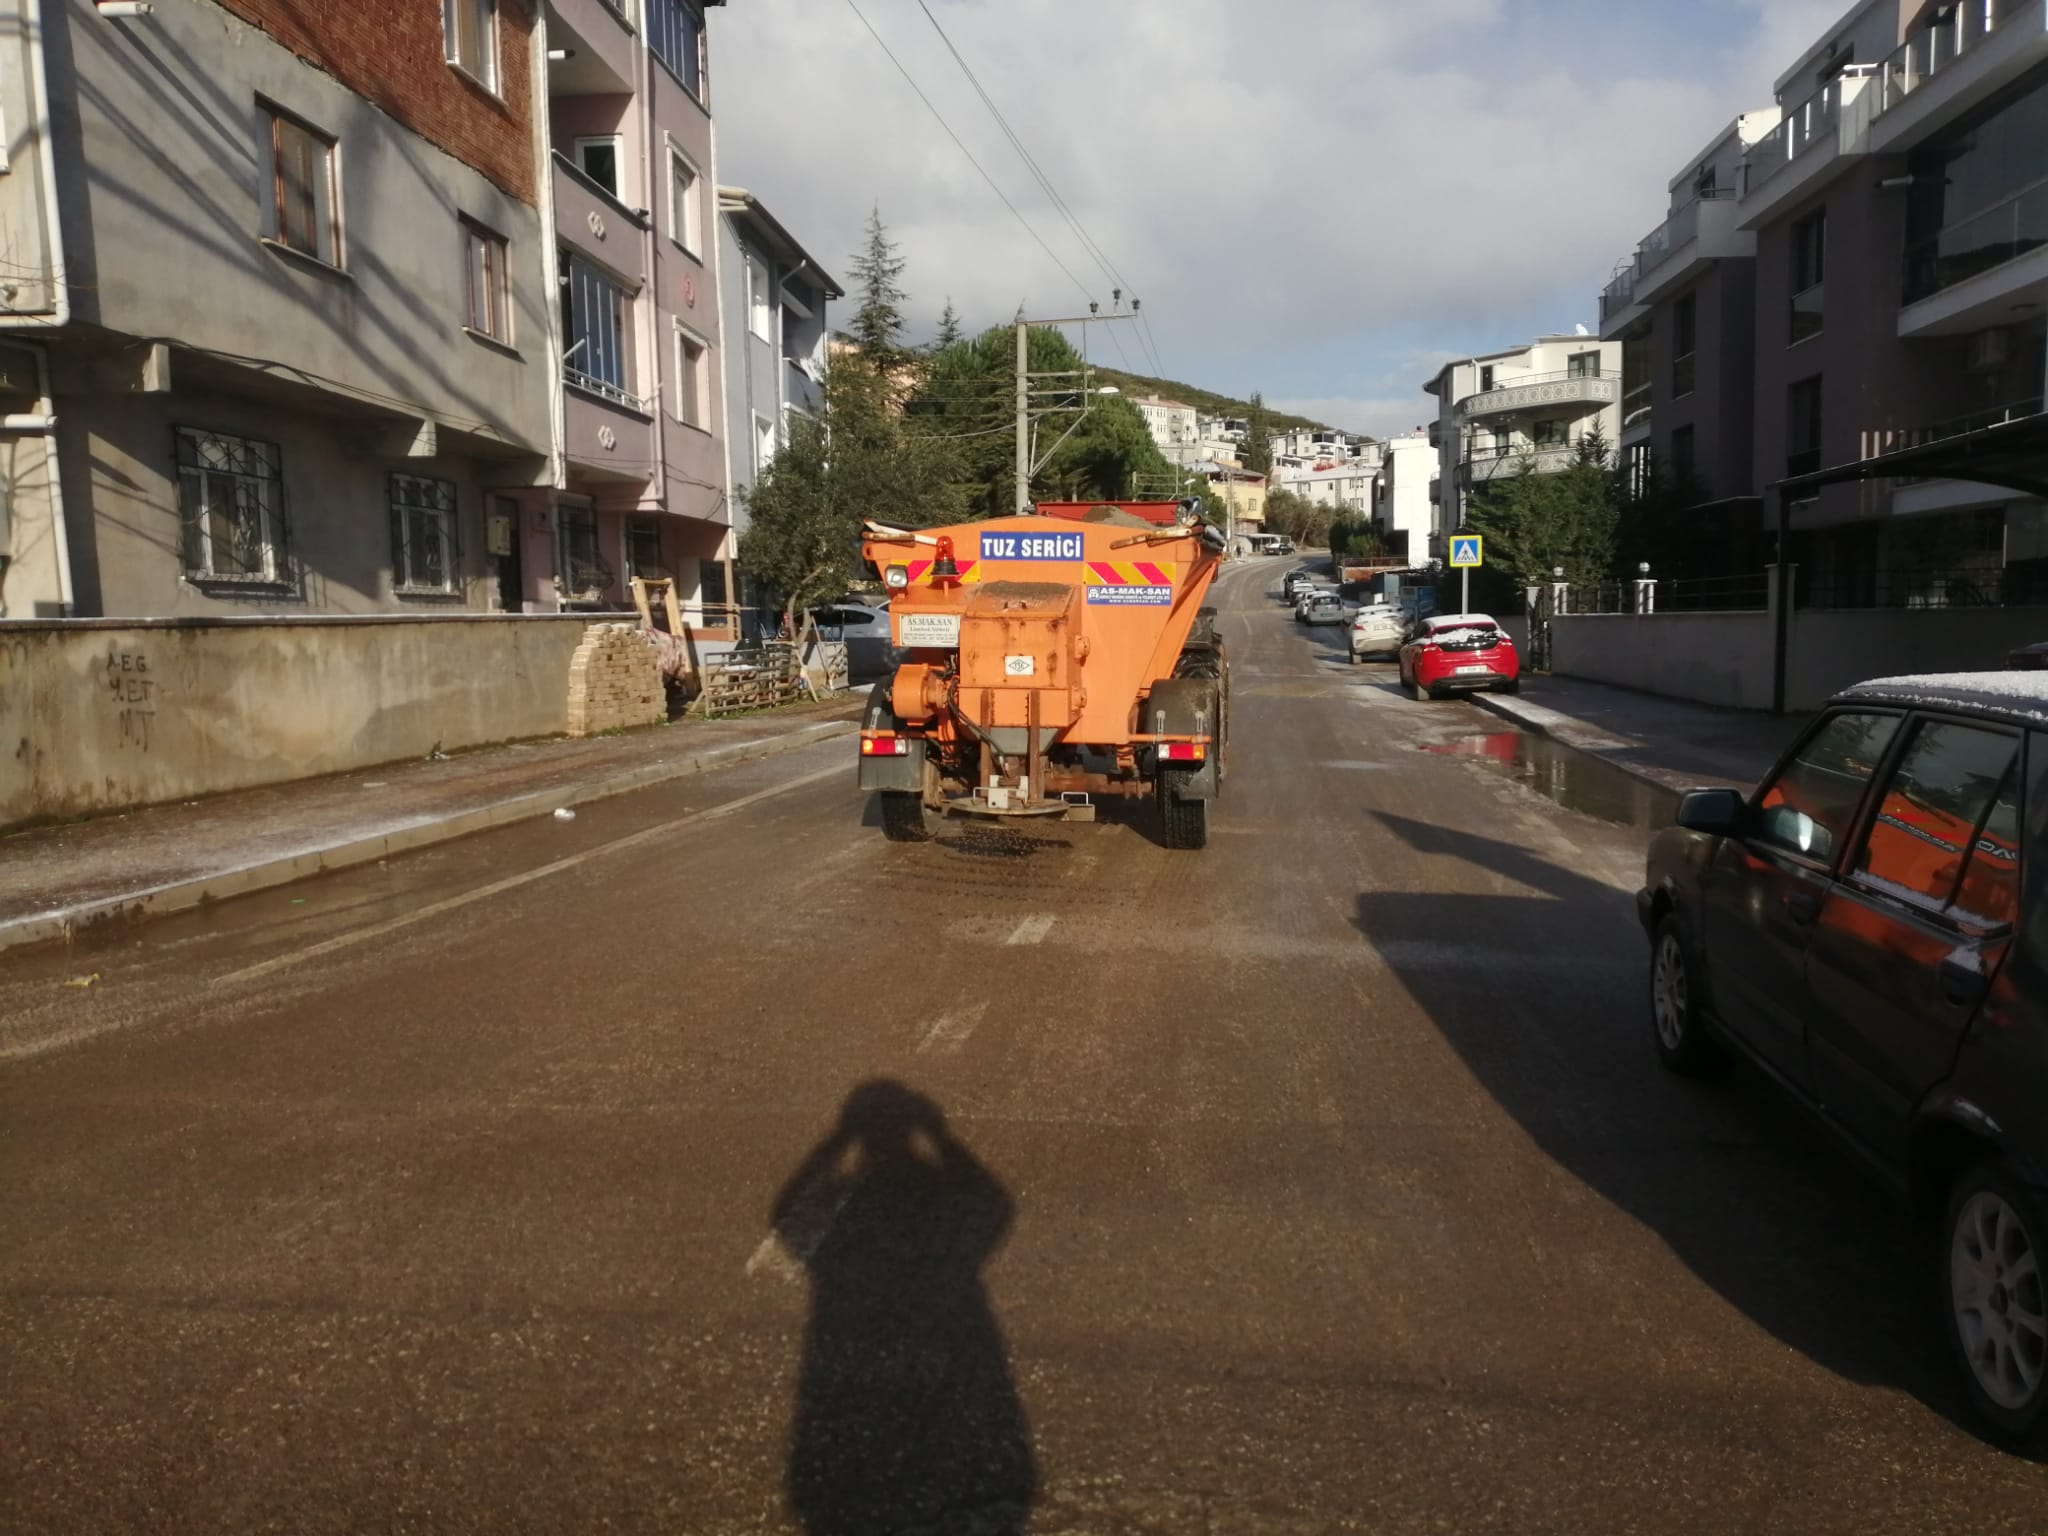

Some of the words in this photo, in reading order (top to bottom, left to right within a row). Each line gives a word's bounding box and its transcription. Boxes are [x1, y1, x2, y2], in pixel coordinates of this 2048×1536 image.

[982, 538, 1016, 557] TUZ
[1021, 535, 1081, 558] SERİCİ
[1100, 587, 1170, 595] AS-MAK-SAN
